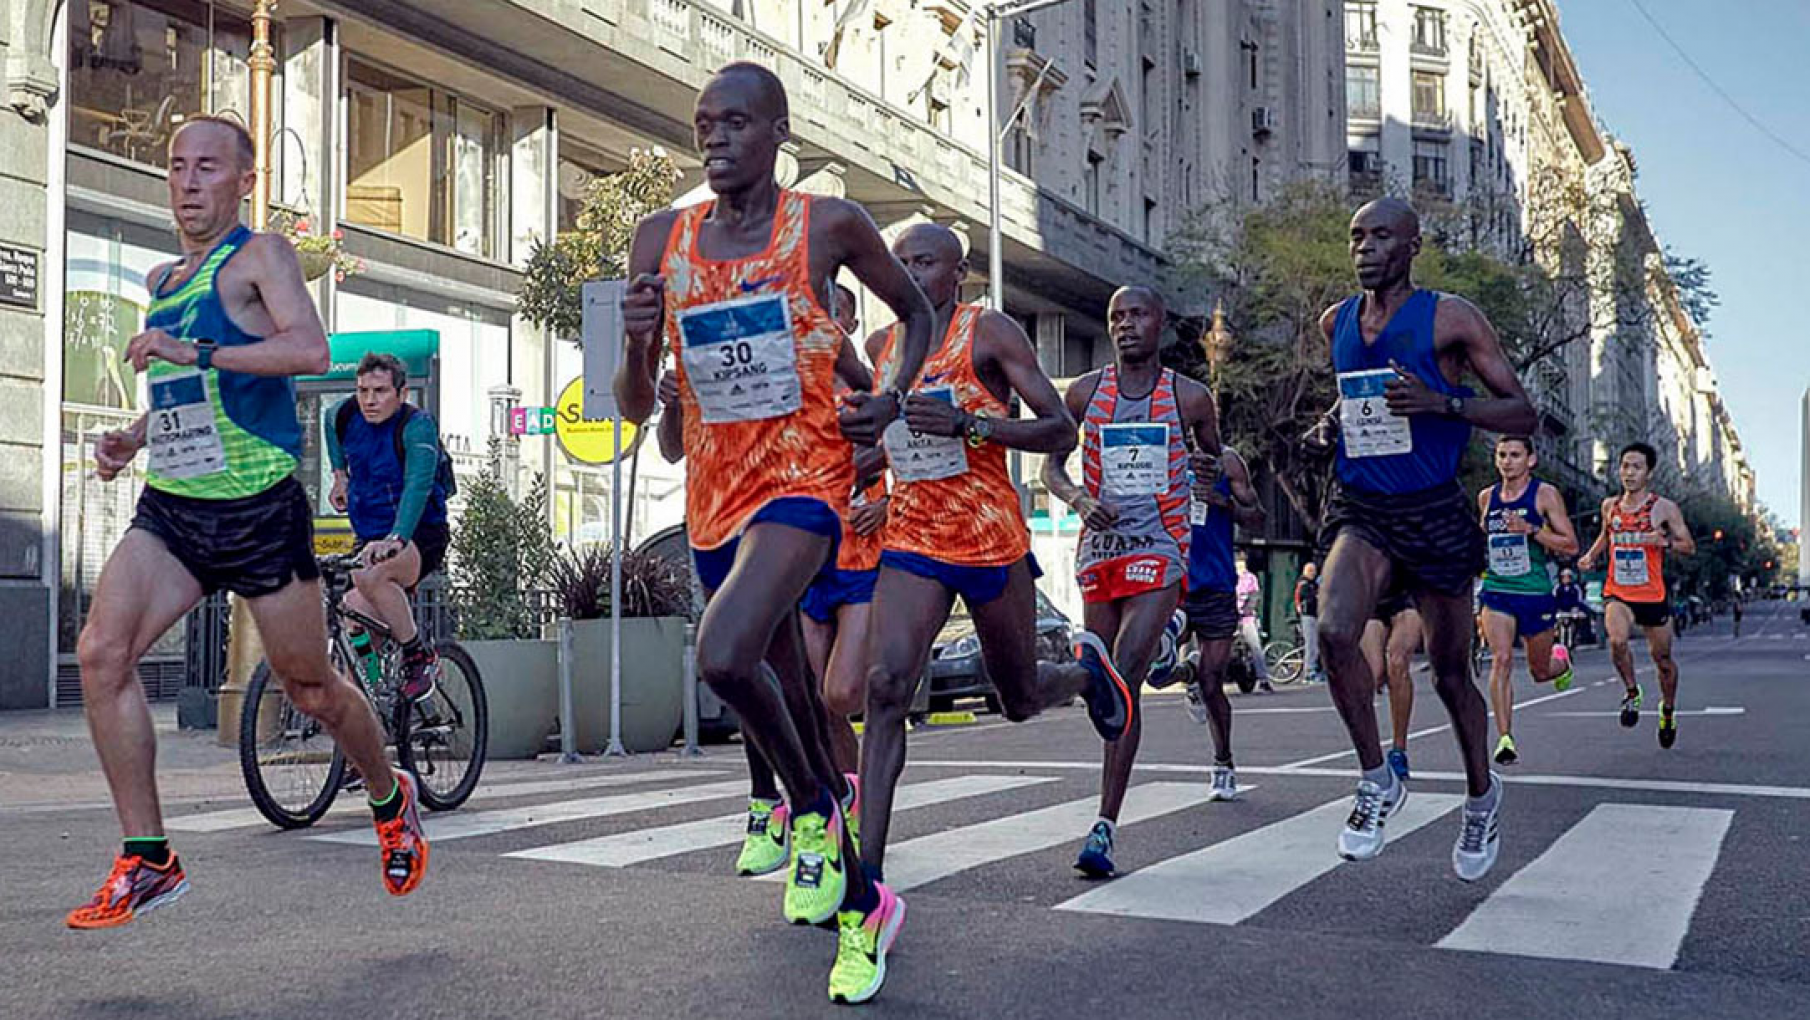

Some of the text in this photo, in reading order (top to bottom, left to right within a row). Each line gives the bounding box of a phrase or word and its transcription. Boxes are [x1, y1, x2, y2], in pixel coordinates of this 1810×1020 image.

[720, 342, 753, 367] 30
[1362, 401, 1372, 416] 6
[160, 410, 181, 431] 31
[514, 413, 554, 429] EAD
[1129, 447, 1139, 462] 7
